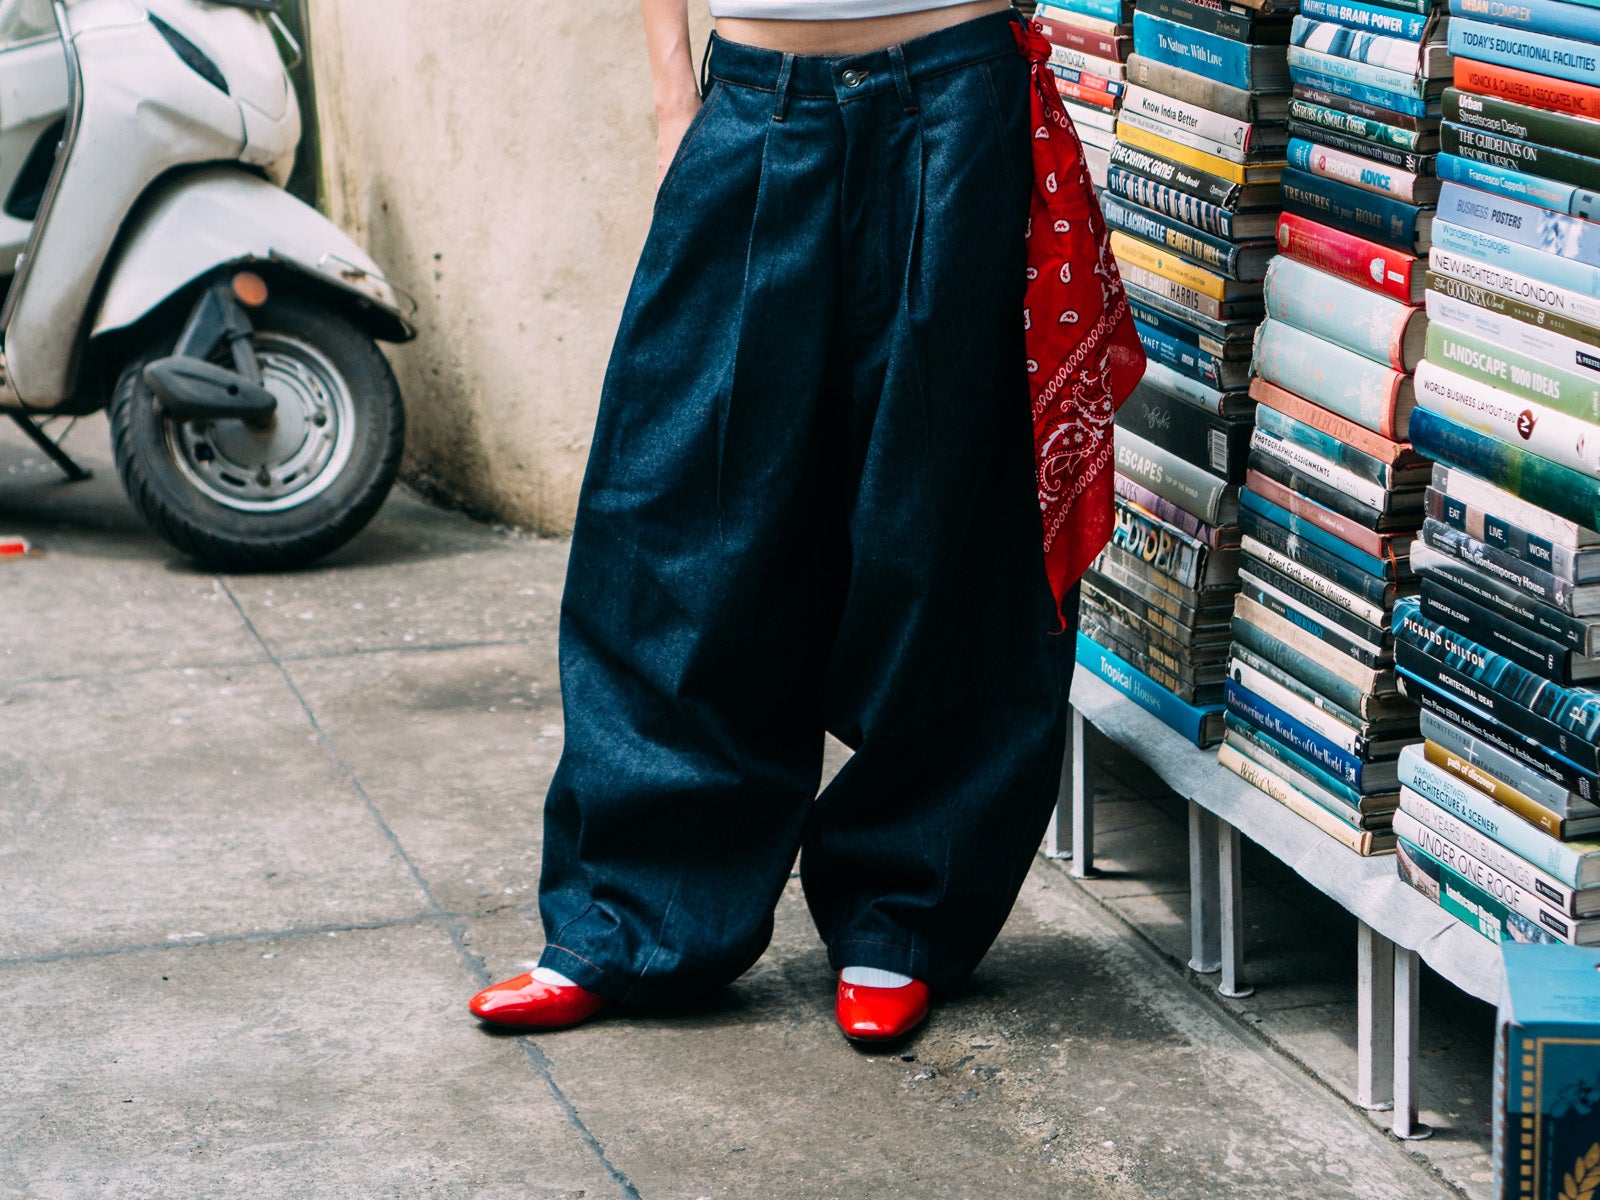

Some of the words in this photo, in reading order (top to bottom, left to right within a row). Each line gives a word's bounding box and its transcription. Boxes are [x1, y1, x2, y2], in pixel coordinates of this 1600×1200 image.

[1490, 1, 1532, 21] COMPLEX
[1055, 49, 1086, 68] MENDOZA
[1462, 31, 1495, 50] TODAY'S
[1495, 39, 1552, 63] EDUCATIONAL
[1553, 50, 1596, 72] FACILITIES
[1142, 97, 1160, 113] Know
[1161, 103, 1177, 120] India
[1177, 110, 1199, 128] Better
[1292, 102, 1316, 123] SHRUBS
[1316, 110, 1323, 123] &
[1323, 110, 1346, 131] SMALL
[1346, 115, 1367, 136] TREES
[1458, 94, 1483, 112] Urban
[1458, 108, 1501, 131] Streetscape
[1501, 119, 1528, 139] Design
[1112, 145, 1127, 160] THE
[1126, 149, 1151, 171] OLYMPIC
[1150, 159, 1175, 180] GAMES
[1382, 149, 1402, 165] WORLD
[1458, 128, 1475, 143] THE
[1475, 134, 1522, 158] GUIDELINES
[1522, 145, 1538, 162] ON
[1458, 145, 1489, 164] RESORT
[1489, 154, 1519, 171] DESIGN
[1360, 168, 1391, 191] ADVICE
[1105, 201, 1125, 226] DAVID
[1124, 208, 1166, 243] LACHAPELLE
[1166, 227, 1192, 253] HEAVEN
[1192, 237, 1203, 255] TO
[1456, 199, 1489, 220] BUSINESS
[1491, 208, 1523, 230] POSTERS
[1442, 223, 1478, 246] Wandering
[1478, 233, 1511, 255] Ecologies
[1170, 282, 1199, 310] HARRIS
[1434, 277, 1446, 291] The
[1447, 280, 1471, 301] GOOD
[1470, 286, 1487, 308] SEX
[1435, 254, 1461, 275] NEW
[1462, 264, 1514, 292] ARCHITECTURE
[1514, 279, 1565, 310] LONDON
[1140, 309, 1159, 326] WORLD
[1443, 340, 1507, 379] LANDSCAPE
[1510, 364, 1531, 388] 1000
[1532, 371, 1560, 400] IDEAS
[1424, 379, 1445, 396] WORLD
[1446, 386, 1476, 408] BUSINESS
[1477, 397, 1502, 418] LAYOUT
[1503, 409, 1516, 423] 300
[1118, 446, 1164, 484] ESCAPES
[1254, 432, 1294, 460] PHOTOGRAPHIC
[1294, 452, 1330, 478] ASSIGNMENTS
[1448, 506, 1461, 520] EAT
[1529, 543, 1550, 561] WORK
[1267, 552, 1285, 568] Planet
[1286, 563, 1302, 577] Earth
[1302, 572, 1315, 583] and
[1326, 584, 1351, 607] Universe
[1460, 546, 1473, 562] The
[1473, 553, 1522, 587] Contemporary
[1522, 576, 1545, 596] House
[1427, 598, 1452, 615] LANDSCAPE
[1450, 608, 1470, 624] ALCHEMY
[1403, 617, 1442, 646] PICKARD
[1444, 641, 1485, 670] CHILTON
[1100, 656, 1132, 690] Tropical
[1133, 680, 1161, 711] Houses
[1438, 672, 1477, 701] ARCHITECTURAL
[1478, 693, 1494, 709] IDEAS
[1228, 689, 1265, 726] Discovering
[1265, 712, 1275, 731] the
[1275, 717, 1302, 746] Wonders
[1302, 738, 1310, 751] of
[1309, 741, 1324, 760] Our
[1323, 749, 1342, 774] World
[1240, 762, 1258, 782] World
[1258, 771, 1266, 785] of
[1414, 765, 1443, 786] HARMONY
[1443, 779, 1469, 803] BETWEEN
[1447, 757, 1461, 772] path
[1461, 764, 1469, 775] of
[1468, 768, 1497, 794] discovery
[1413, 775, 1461, 813] ARCHITECTURE
[1461, 805, 1467, 817] &
[1468, 808, 1499, 836] SCENERY
[1414, 802, 1431, 823] 100
[1432, 811, 1461, 842] YEARS
[1463, 828, 1479, 849] 100
[1480, 838, 1531, 886] BUILDINGS
[1417, 827, 1455, 867] UNDER
[1457, 855, 1485, 887] ONE
[1486, 872, 1522, 910] ROOF
